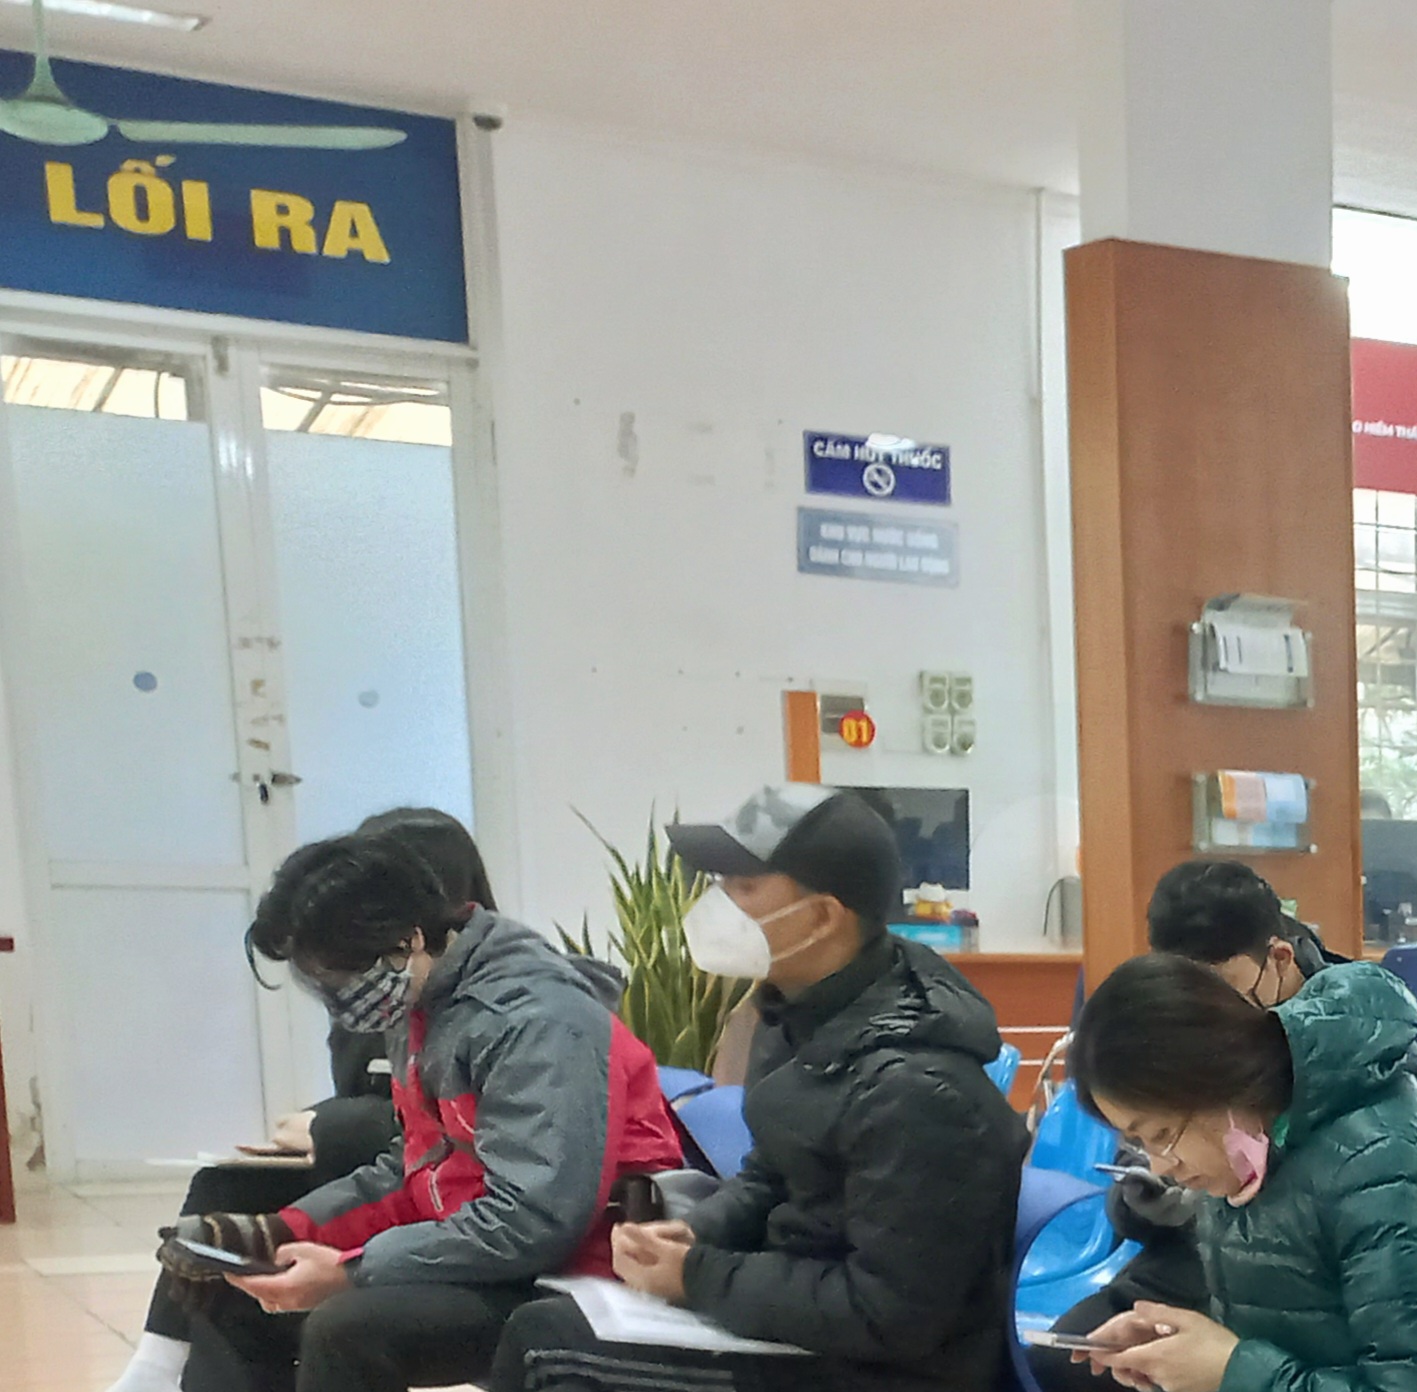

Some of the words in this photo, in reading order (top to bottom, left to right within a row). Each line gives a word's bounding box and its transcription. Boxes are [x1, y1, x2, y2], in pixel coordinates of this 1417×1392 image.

[45, 154, 213, 242] LỐI
[249, 188, 391, 265] RA
[841, 717, 870, 744] 01
